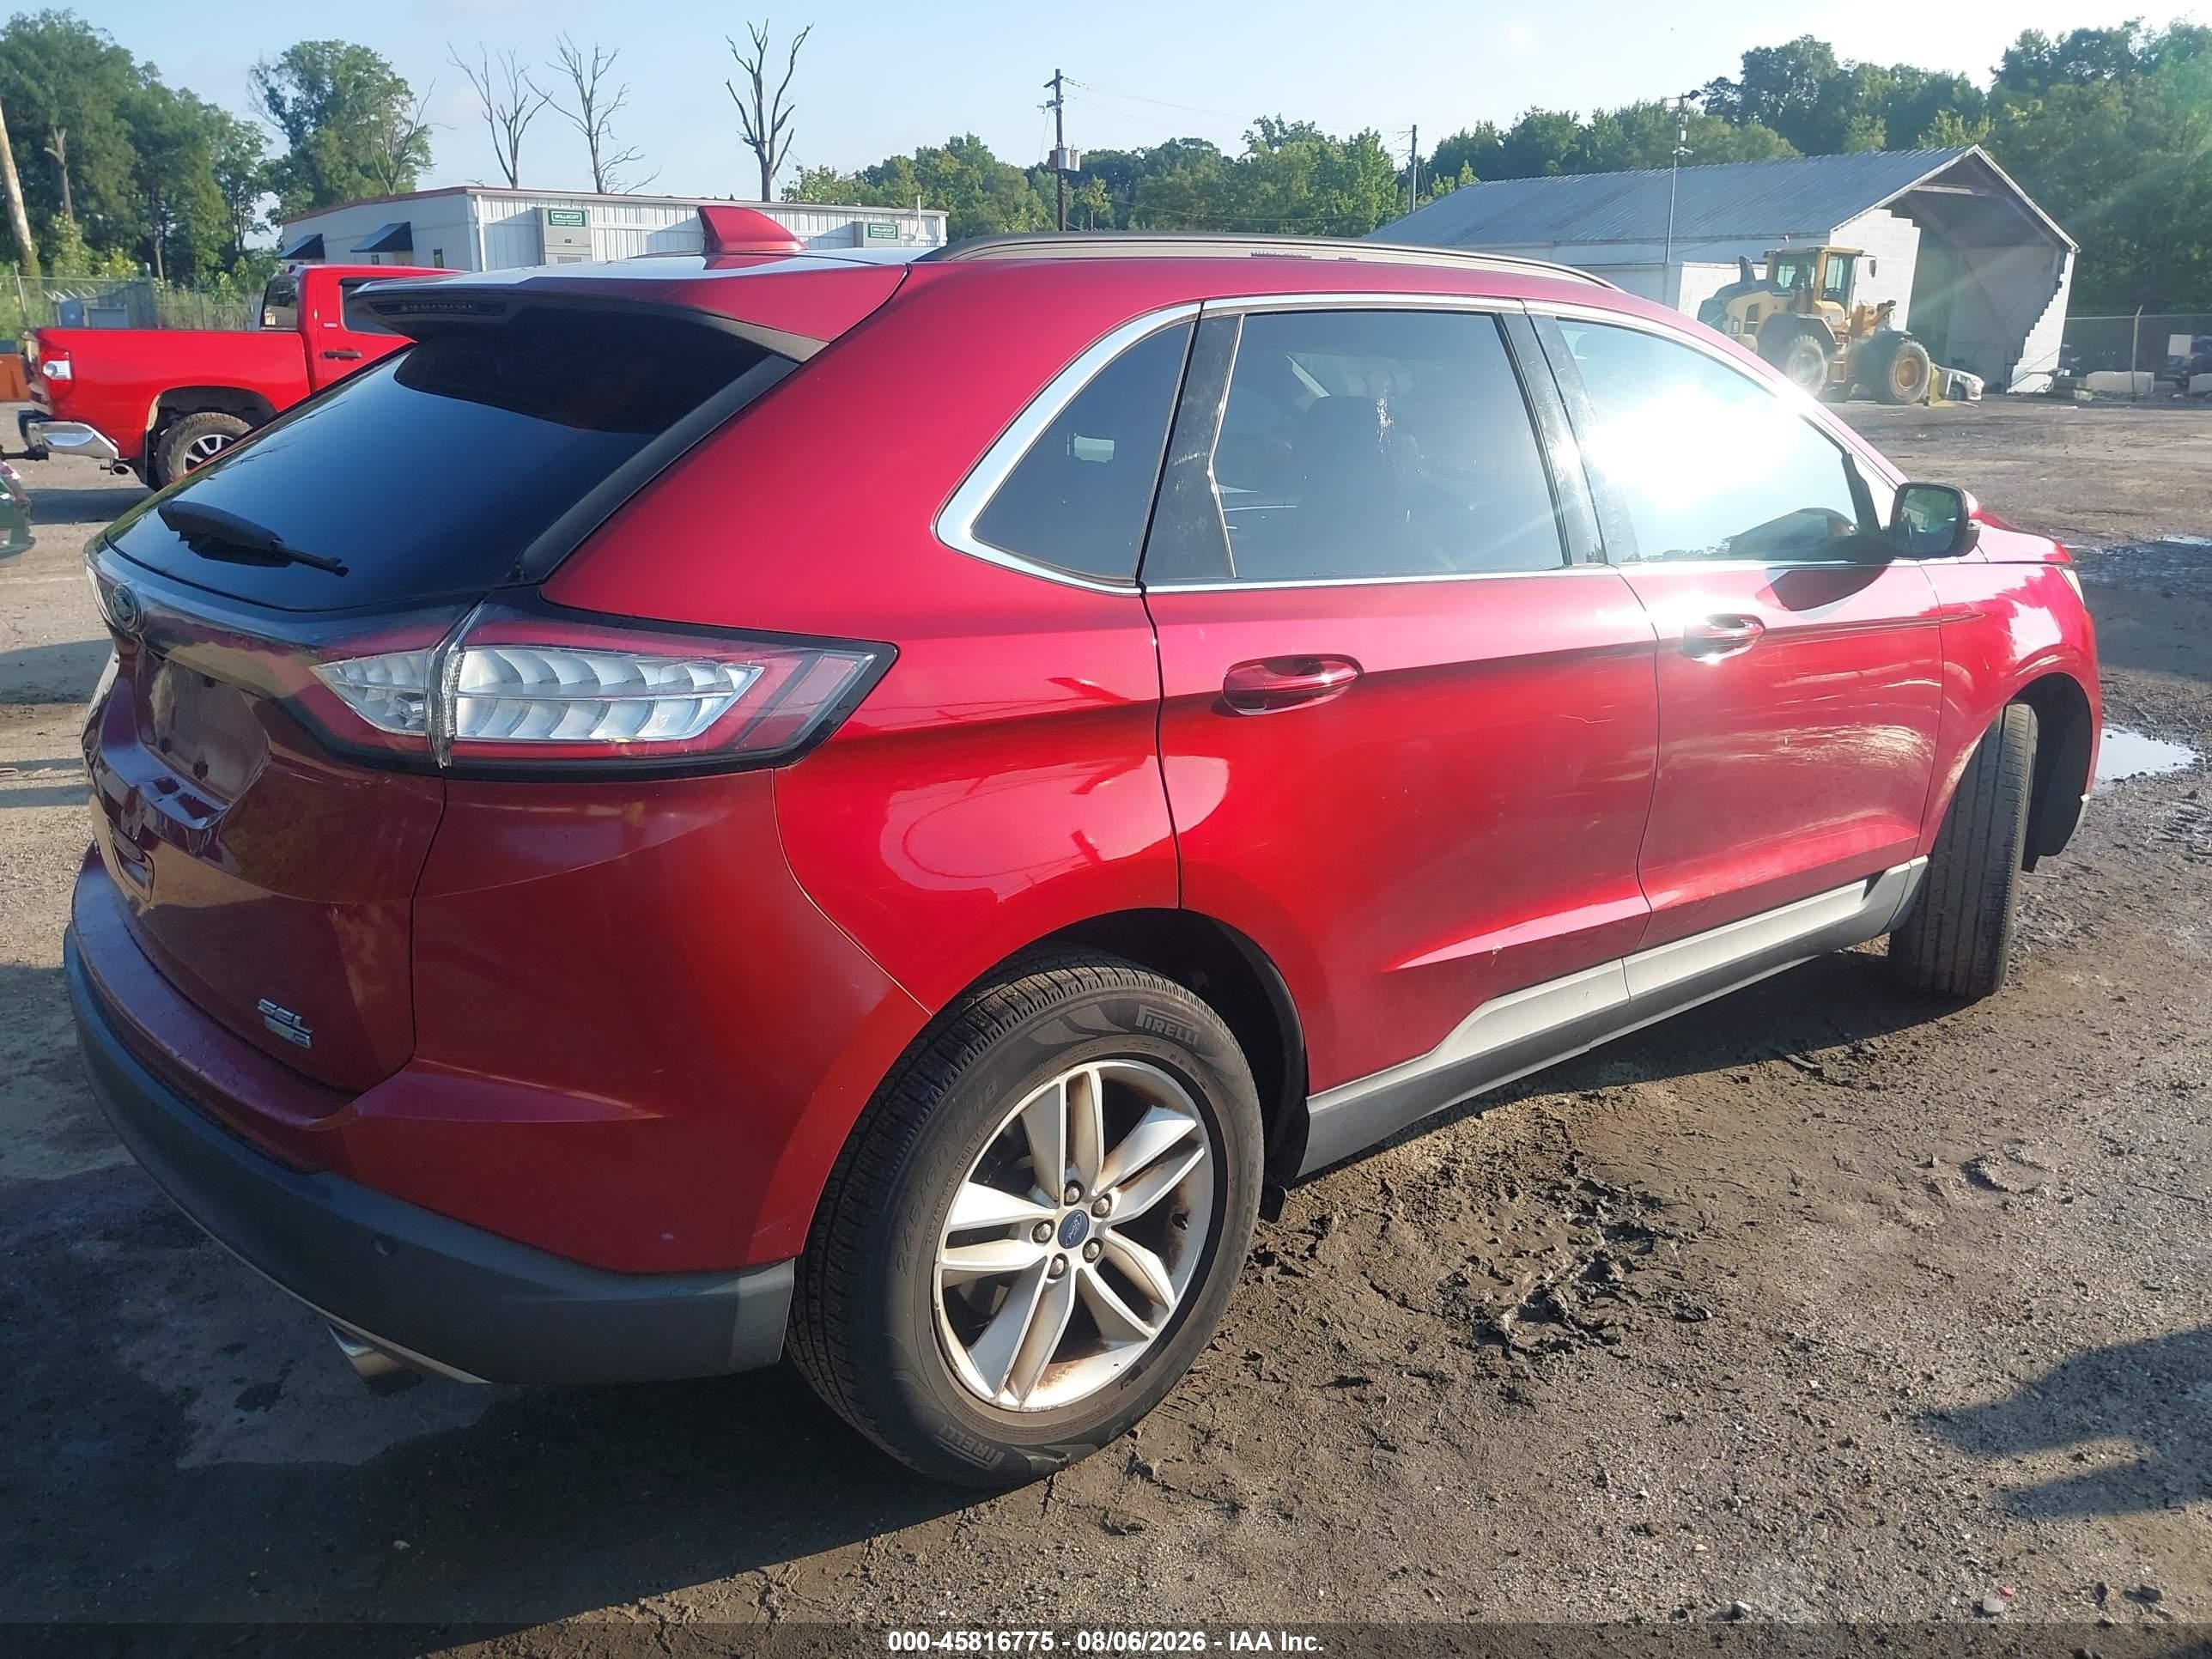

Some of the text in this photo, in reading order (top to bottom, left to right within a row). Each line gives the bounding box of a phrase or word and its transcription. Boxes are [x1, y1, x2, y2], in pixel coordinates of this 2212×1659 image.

[257, 998, 313, 1034] SEL
[1134, 1004, 1201, 1047] PIRELLI
[934, 1423, 1005, 1470] PIRELLI
